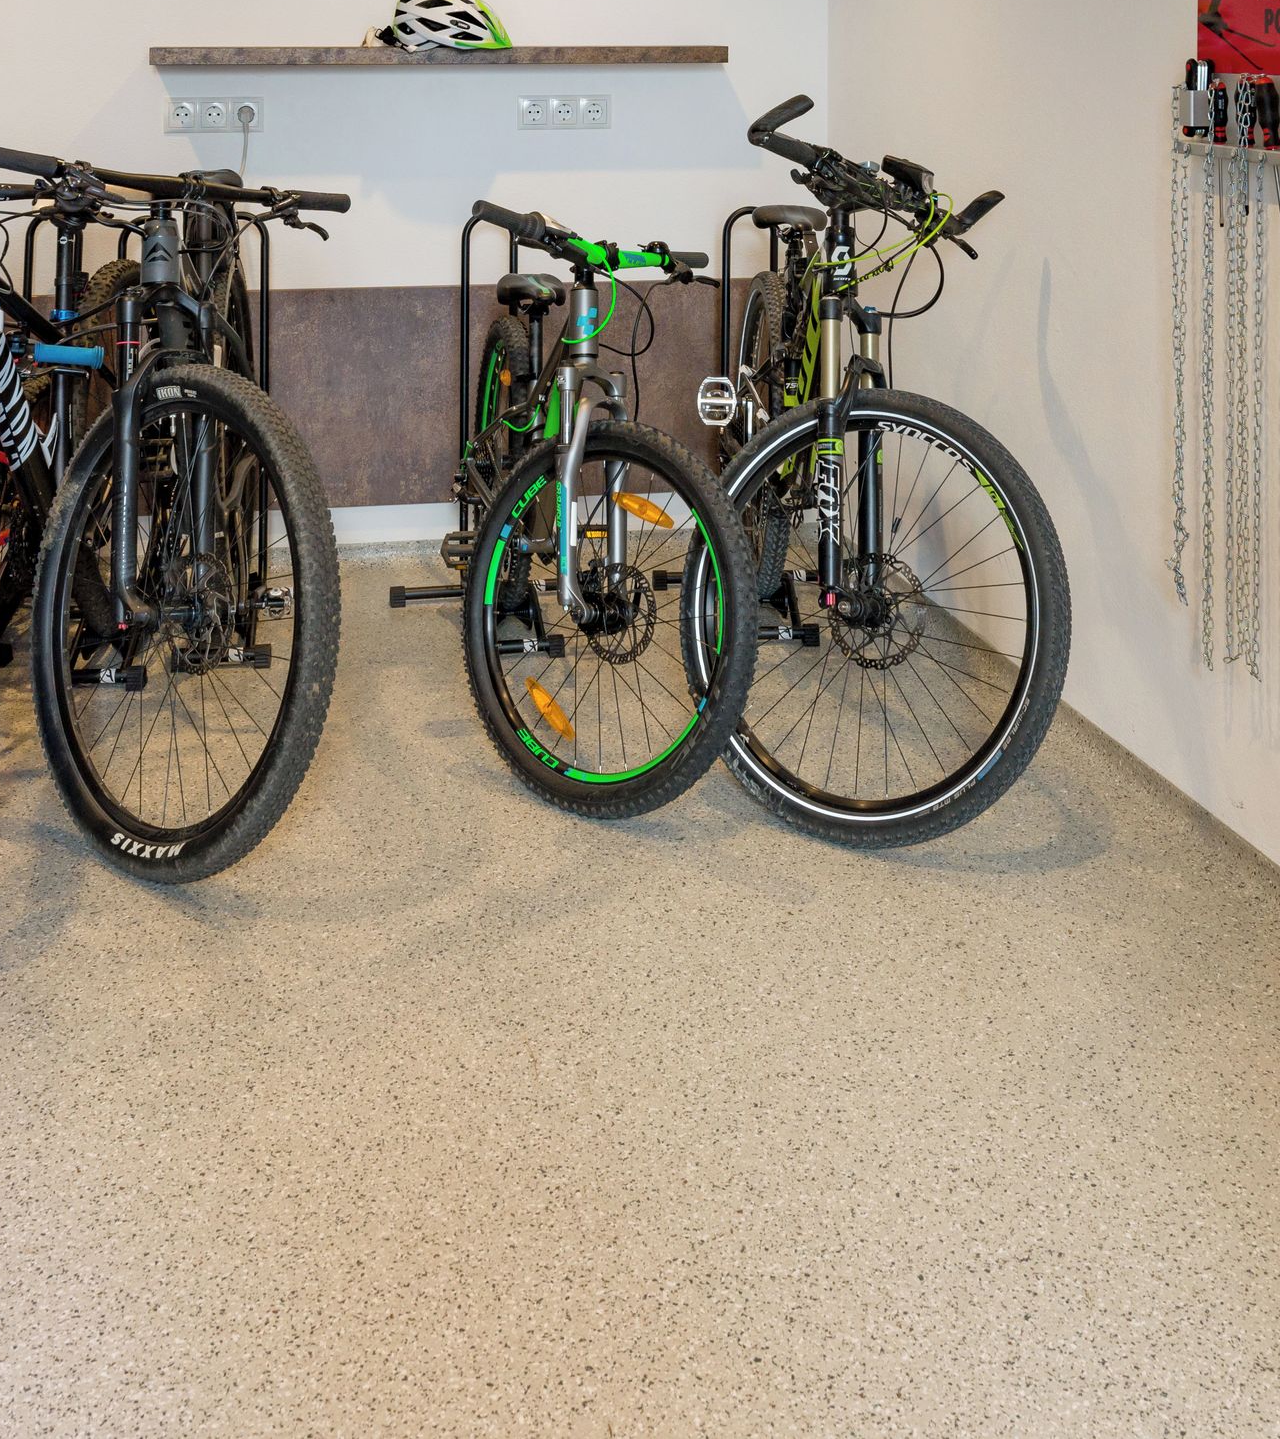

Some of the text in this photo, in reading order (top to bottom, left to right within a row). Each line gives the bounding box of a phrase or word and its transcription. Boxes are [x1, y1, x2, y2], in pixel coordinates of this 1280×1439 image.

[156, 385, 182, 400] IKON
[511, 474, 547, 519] CUBE
[516, 728, 560, 769] CUBE
[110, 832, 187, 859] MAXXIS
